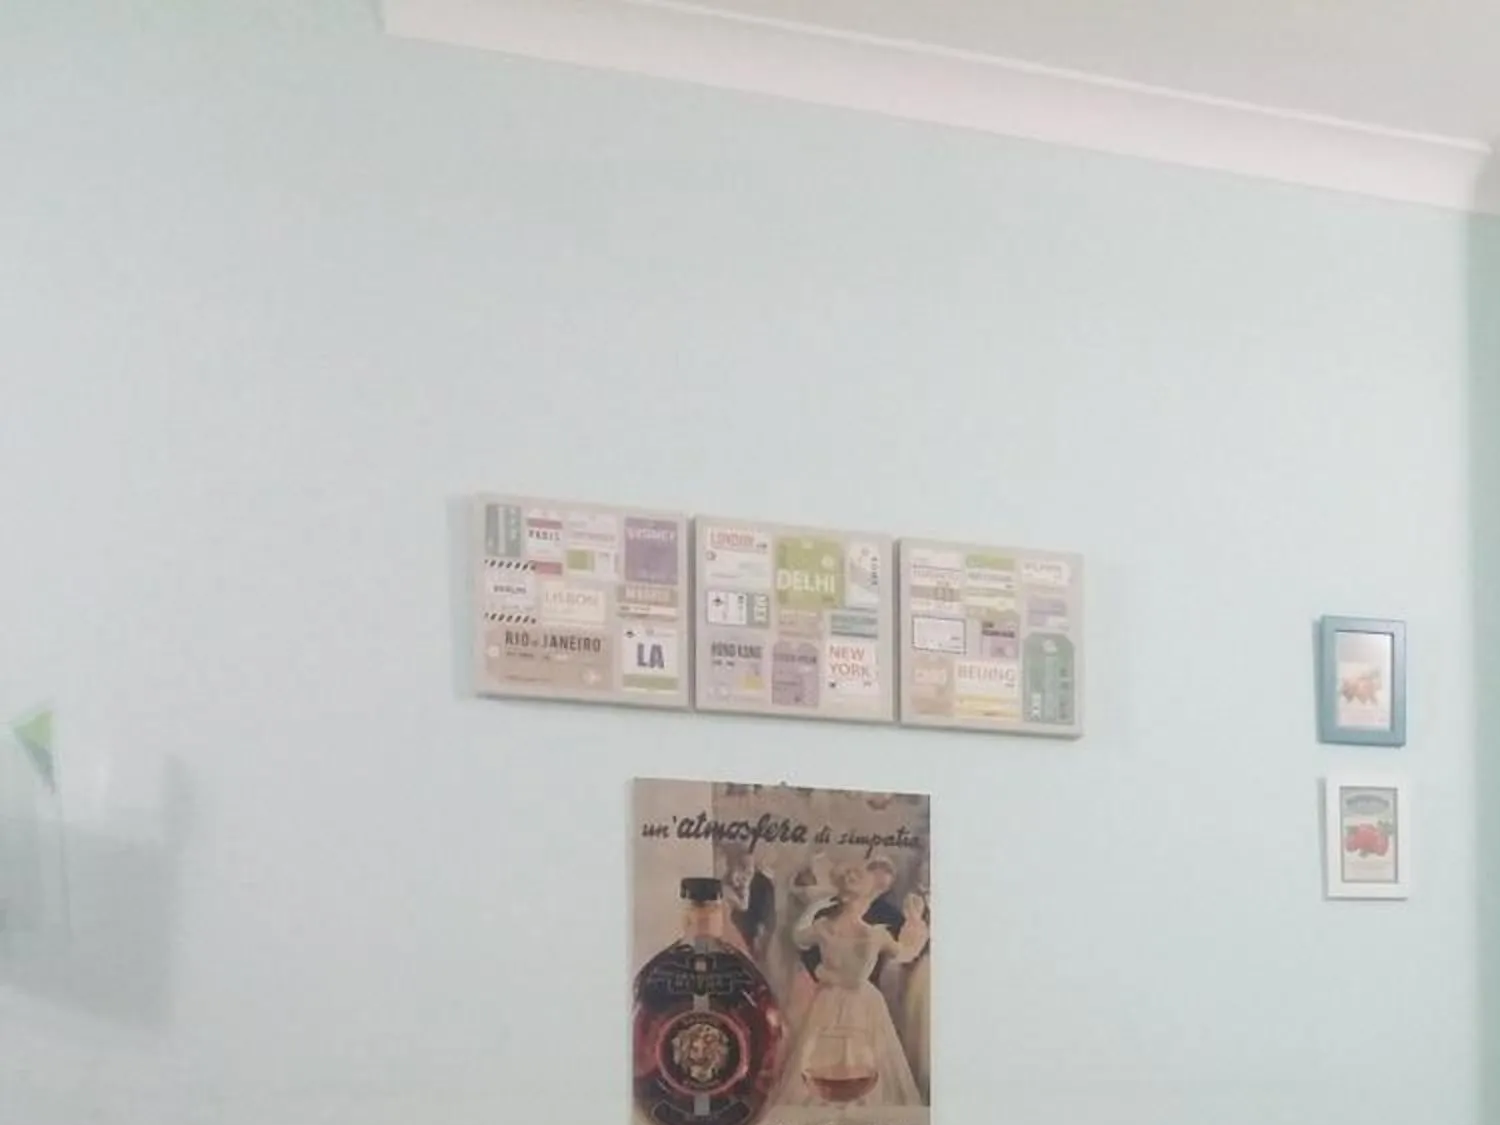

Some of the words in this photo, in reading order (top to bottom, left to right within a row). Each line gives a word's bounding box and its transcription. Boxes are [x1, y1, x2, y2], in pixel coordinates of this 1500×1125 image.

[776, 569, 836, 593] DELHI
[541, 632, 602, 653] JANEIRO
[636, 643, 665, 669] LA
[829, 645, 865, 661] NEW
[829, 662, 871, 678] YORK
[814, 825, 831, 845] di
